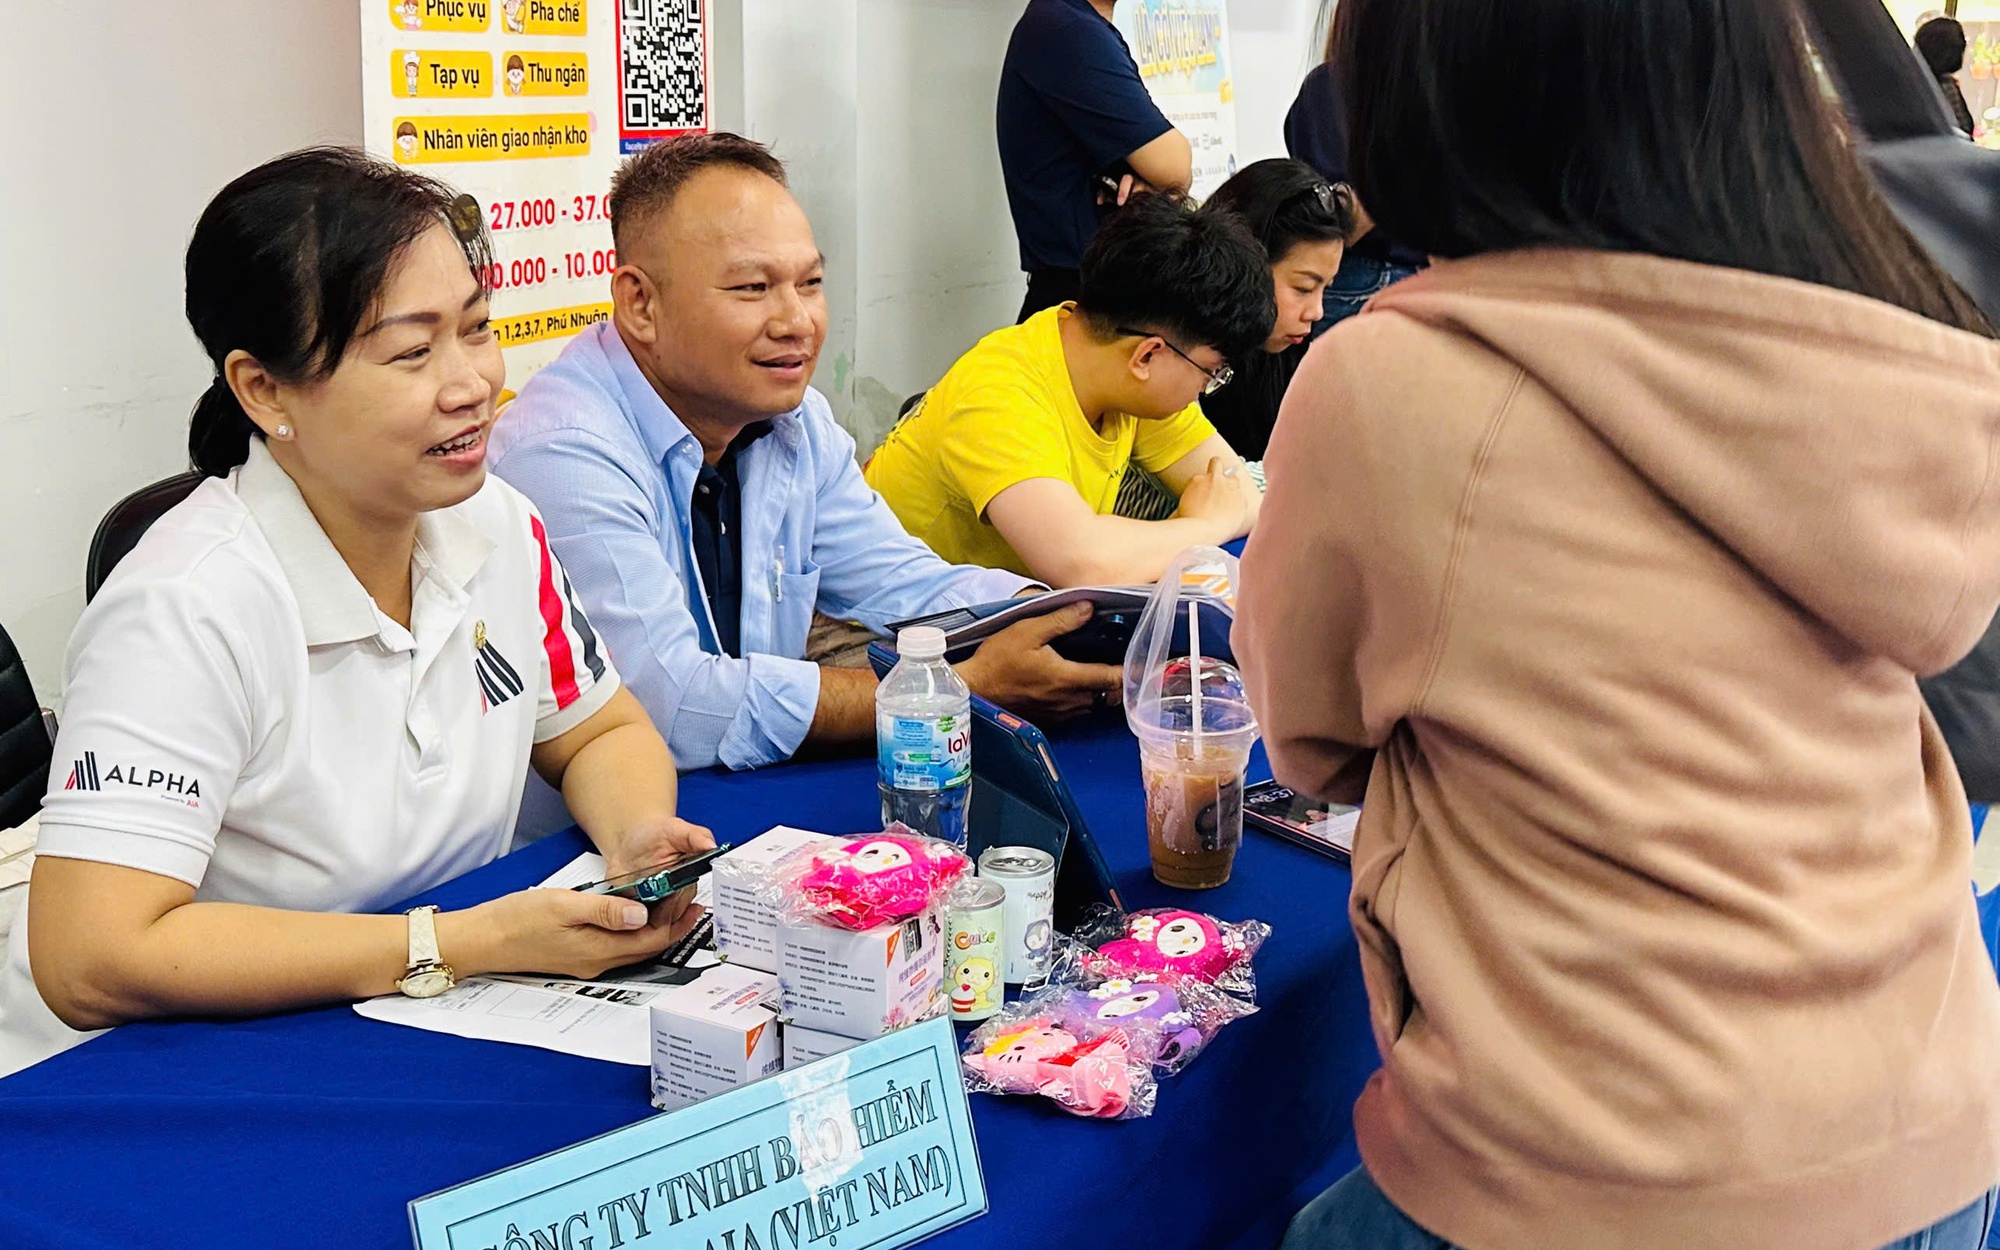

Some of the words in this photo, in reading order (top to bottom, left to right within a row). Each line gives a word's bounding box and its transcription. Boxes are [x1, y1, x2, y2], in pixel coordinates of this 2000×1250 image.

[426, 0, 464, 22] Phục
[468, 3, 486, 23] vụ
[530, 1, 554, 21] Pha
[558, 1, 580, 22] chế
[430, 64, 457, 90] Tạp
[461, 68, 480, 89] vụ
[528, 63, 552, 83] Thu
[555, 63, 585, 87] ngân
[424, 129, 463, 150] Nhân
[467, 128, 497, 148] viên
[502, 128, 529, 152] giao
[532, 126, 562, 150] nhận
[565, 125, 587, 145] kho
[490, 198, 555, 230] 27.000
[547, 313, 567, 332] Phú
[104, 764, 200, 798] ALPHA
[955, 927, 996, 950] Cute
[480, 1211, 594, 1250] ÔNG
[598, 1187, 652, 1250] TY
[657, 1145, 767, 1227] TNHH
[768, 1113, 843, 1184] BẢO
[851, 1079, 938, 1150] HIỂM
[704, 1222, 763, 1250] IA
[770, 1178, 858, 1250] (VIỆT
[864, 1145, 952, 1217] NAM)
